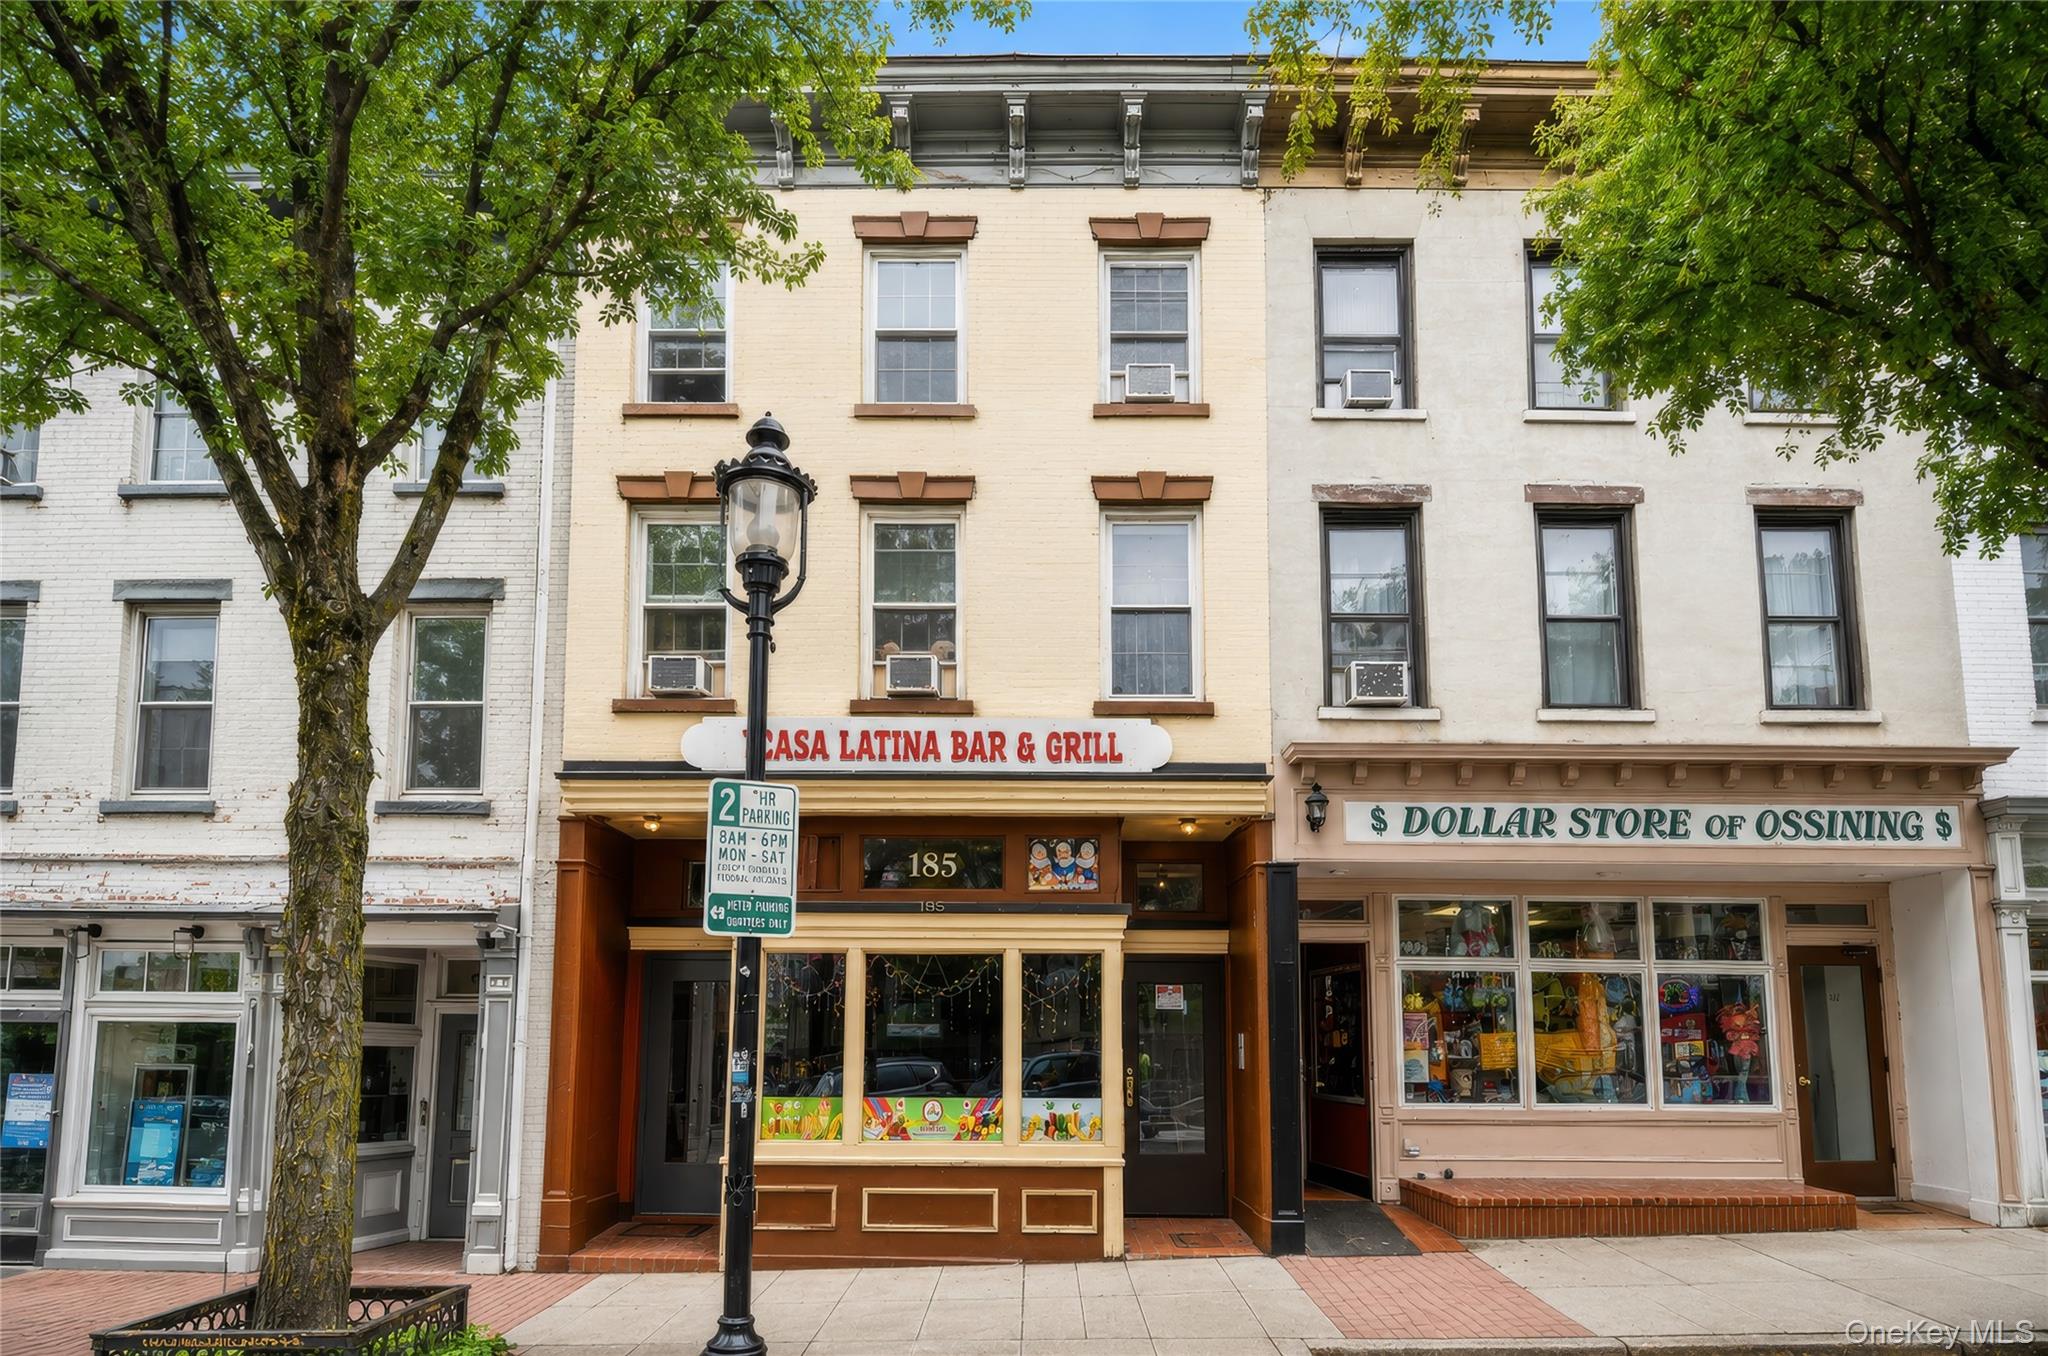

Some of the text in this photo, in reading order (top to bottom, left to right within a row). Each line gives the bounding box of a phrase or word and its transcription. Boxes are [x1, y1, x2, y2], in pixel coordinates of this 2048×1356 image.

[839, 729, 942, 763] LATINA
[950, 730, 1008, 763] BAR
[1016, 731, 1036, 764] &
[1045, 731, 1124, 764] GRILL
[719, 787, 777, 821] 2 HR
[742, 807, 790, 826] PARKING
[1371, 805, 1953, 842] $ DOLLAR STORE OF OSSINING $
[719, 829, 747, 846] 8AM
[761, 832, 788, 849] 6PM
[718, 847, 746, 862] MON
[761, 850, 786, 865] SAT
[908, 852, 957, 878] 185
